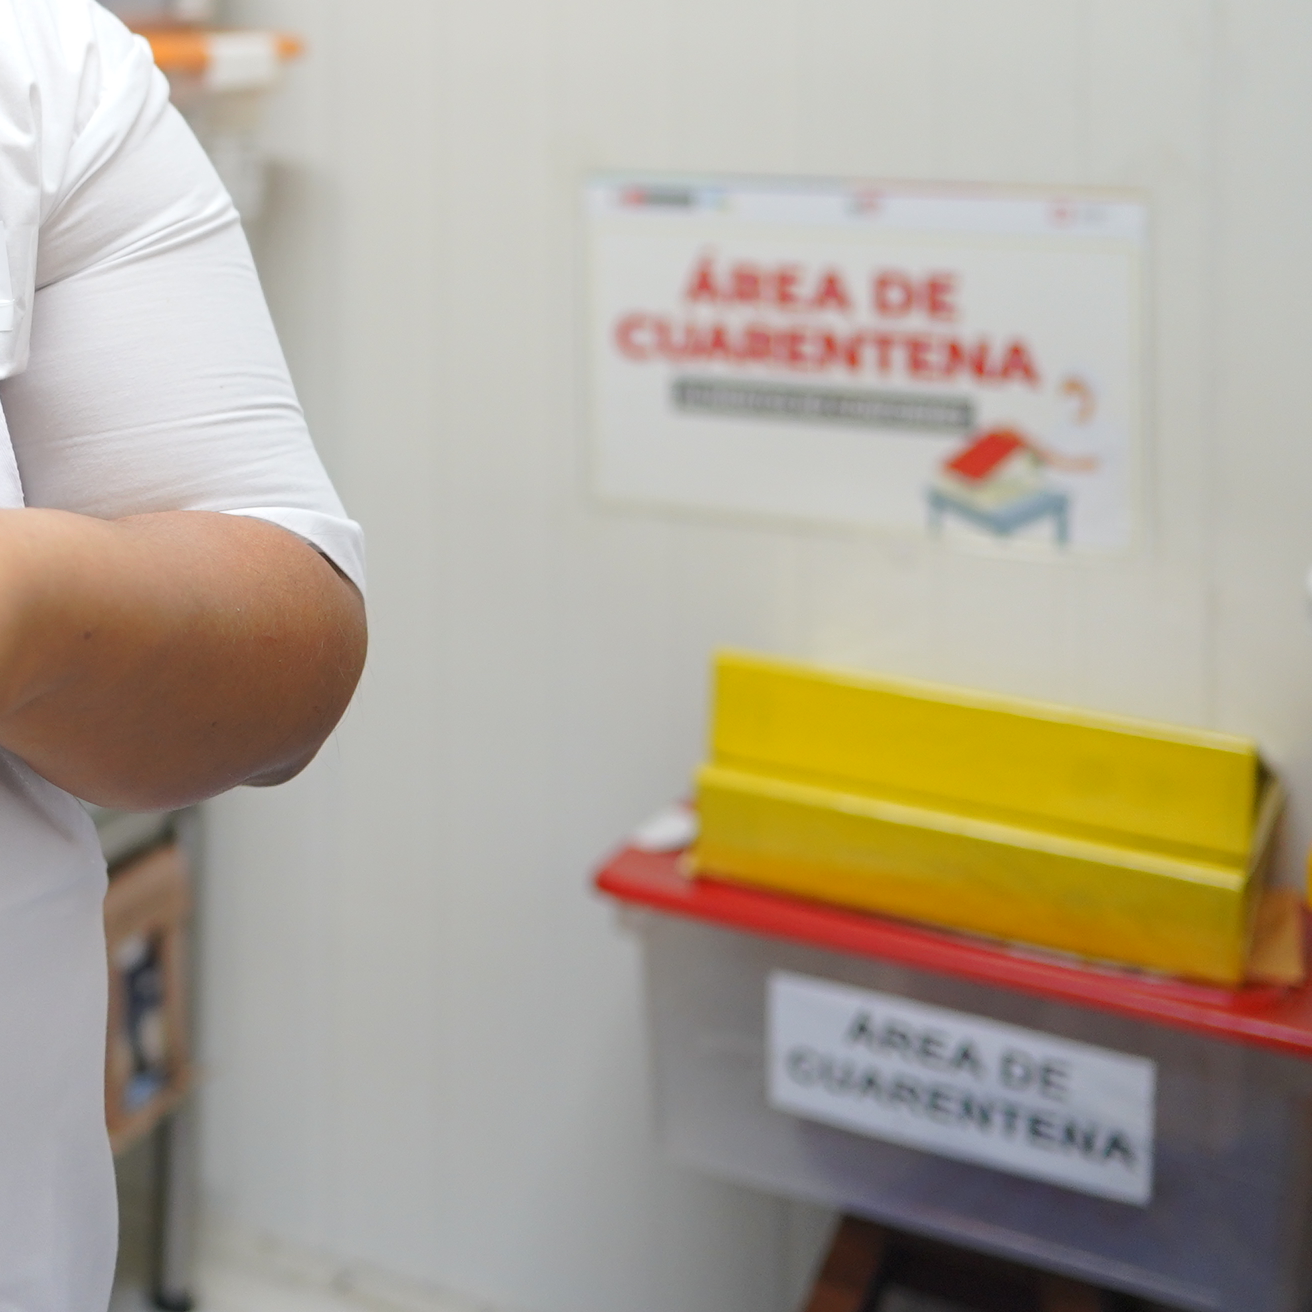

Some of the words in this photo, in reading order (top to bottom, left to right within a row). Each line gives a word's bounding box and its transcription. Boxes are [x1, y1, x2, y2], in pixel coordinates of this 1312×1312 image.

[870, 266, 962, 321] DE
[613, 310, 1041, 387] CUARENTENA
[1000, 1045, 1070, 1101] DE
[785, 1045, 1140, 1168] CUARENTENA
